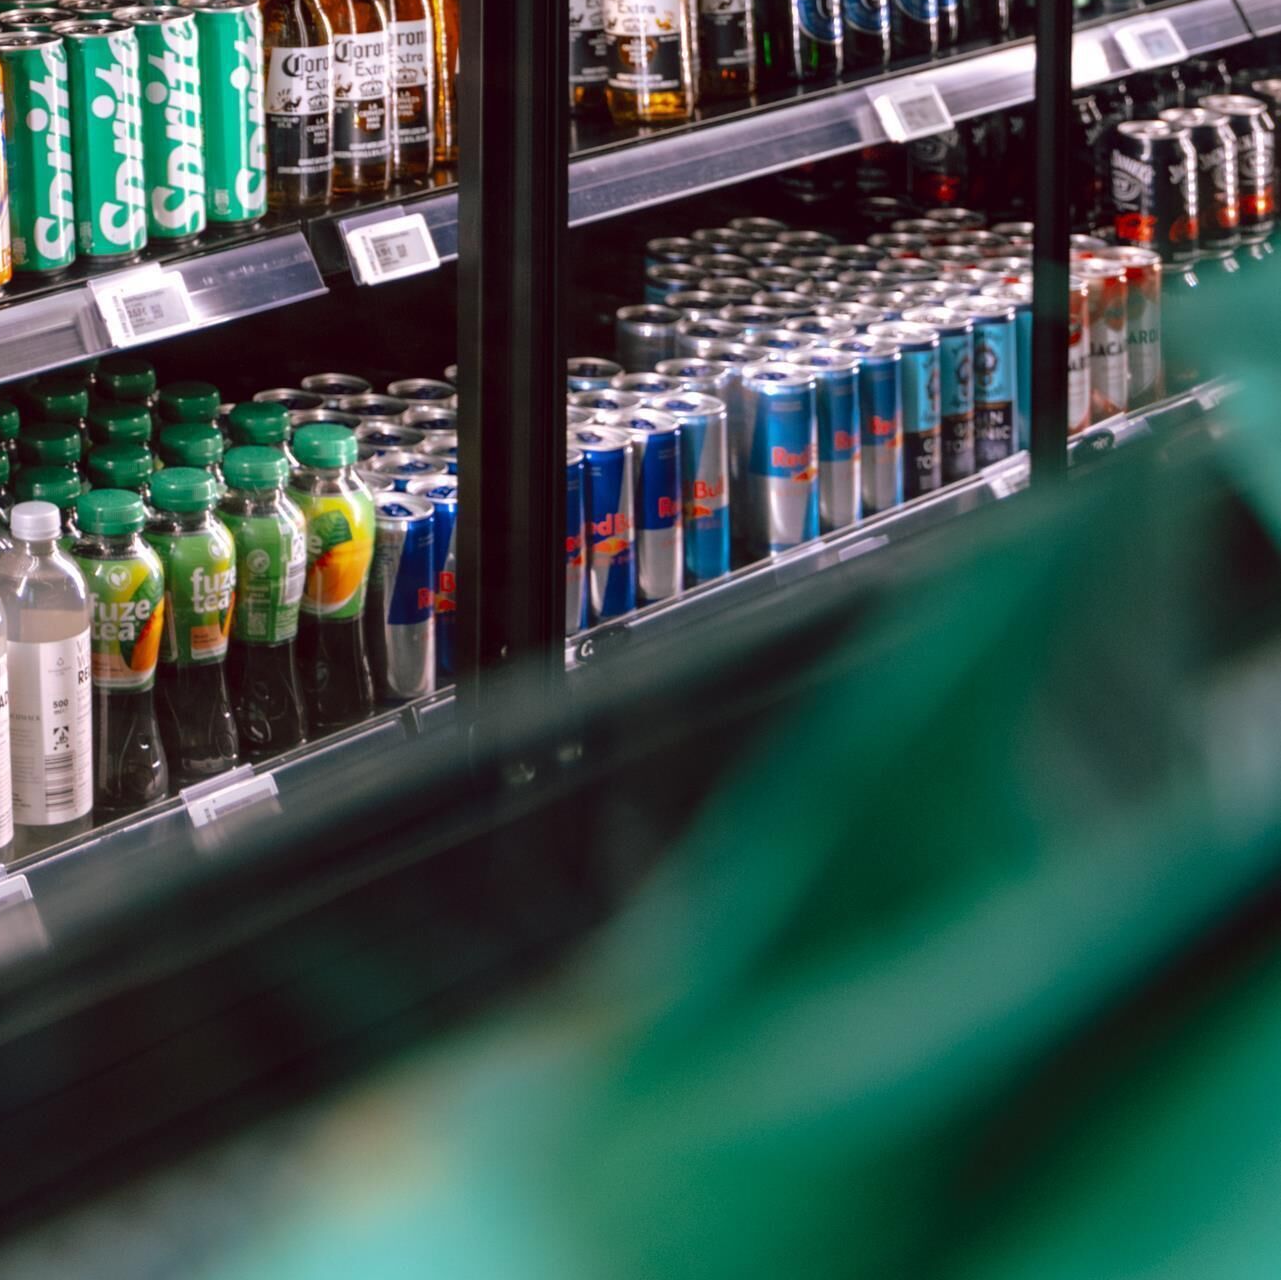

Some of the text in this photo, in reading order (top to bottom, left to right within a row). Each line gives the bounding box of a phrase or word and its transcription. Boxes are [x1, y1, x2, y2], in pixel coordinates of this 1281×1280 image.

[281, 52, 329, 78] Coro
[145, 15, 206, 229] Sprite
[91, 32, 147, 246] Sprite
[89, 591, 152, 622] fuze
[192, 590, 230, 614] tea
[92, 619, 136, 642] tea
[52, 698, 69, 709] 500
